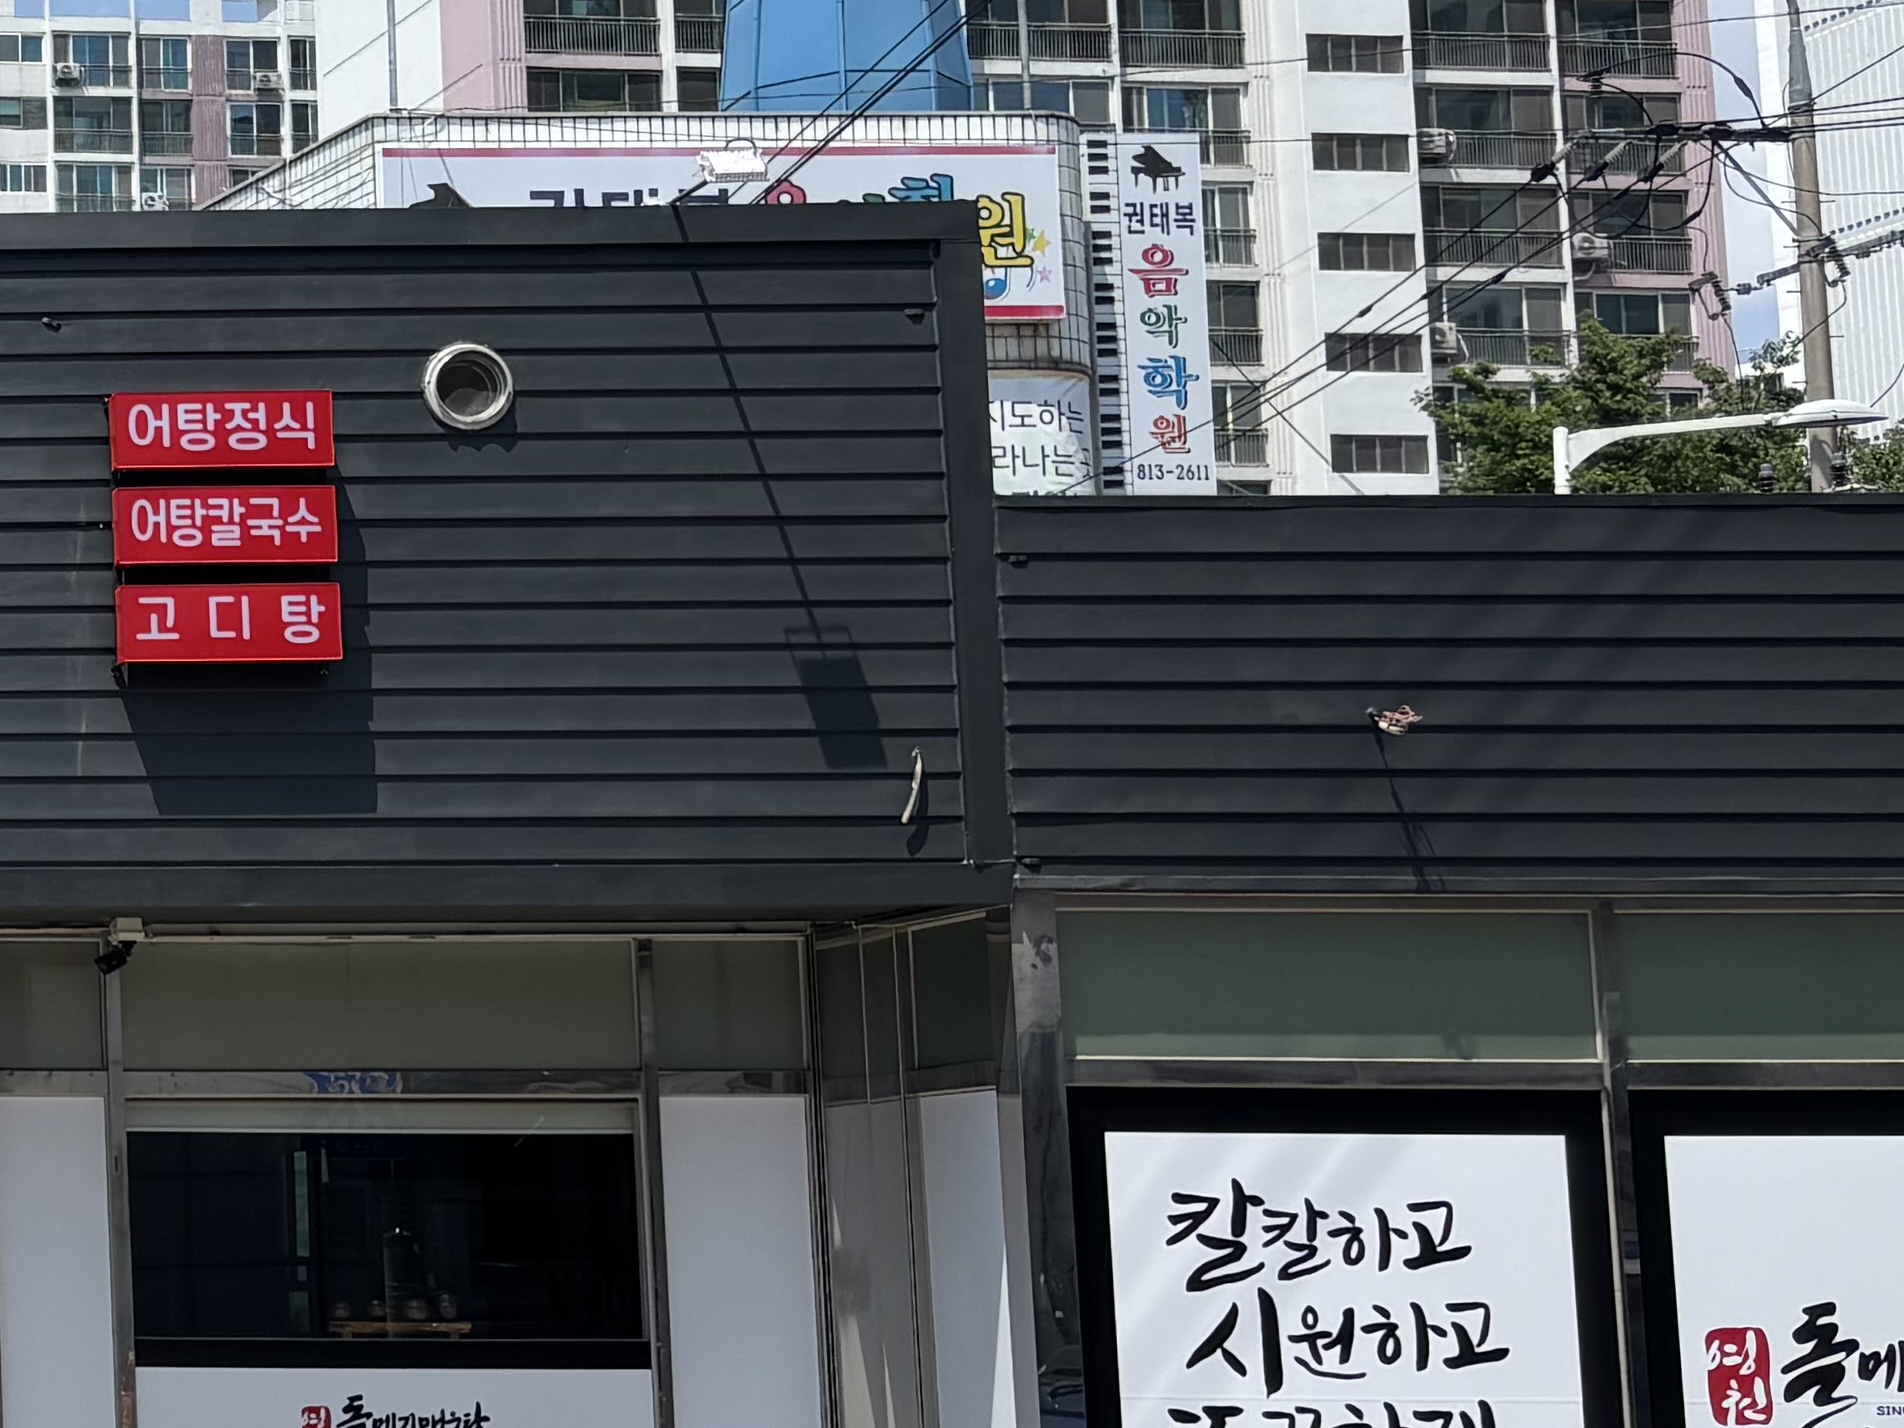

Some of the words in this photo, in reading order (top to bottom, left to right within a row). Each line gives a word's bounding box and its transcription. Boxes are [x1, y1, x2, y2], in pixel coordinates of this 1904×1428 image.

[1123, 201, 1196, 236] 권태복
[1128, 244, 1199, 454] 음악학원
[128, 401, 316, 452] 어탕정식
[1137, 464, 1210, 481] 813-2611
[131, 497, 322, 547] 어탕칼국수
[1165, 1177, 1472, 1292] 칼칼하고
[1185, 1287, 1510, 1399] 시원하고
[1706, 1330, 1768, 1426] 영천
